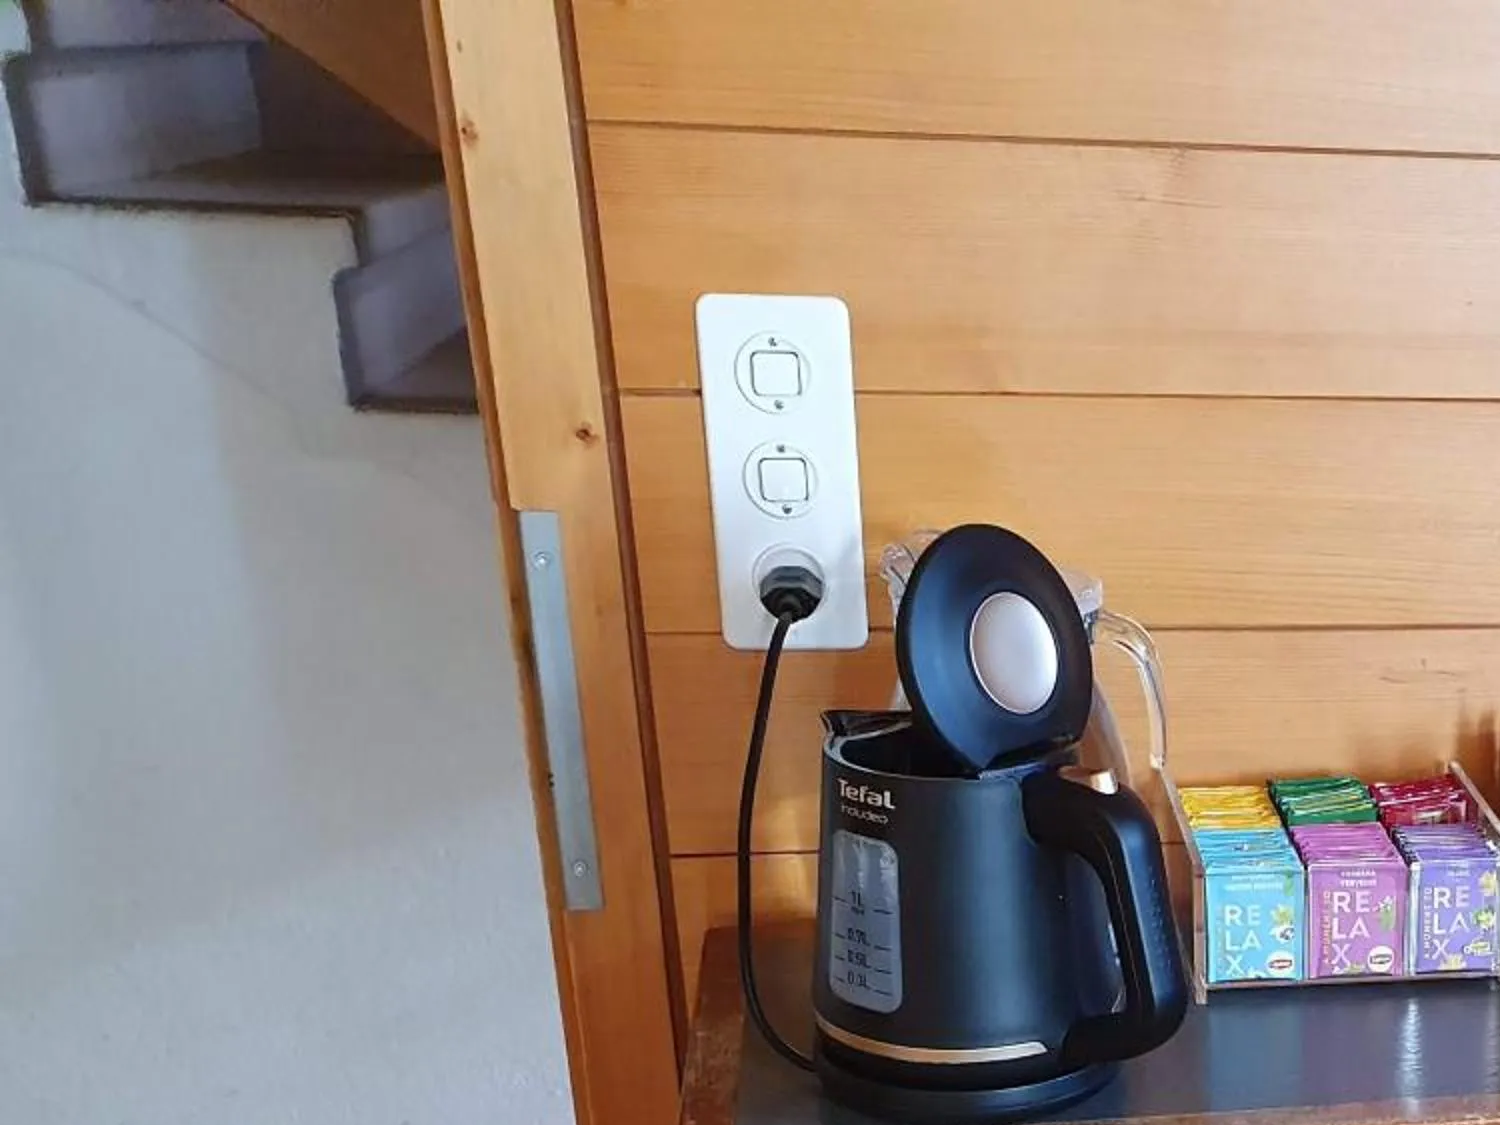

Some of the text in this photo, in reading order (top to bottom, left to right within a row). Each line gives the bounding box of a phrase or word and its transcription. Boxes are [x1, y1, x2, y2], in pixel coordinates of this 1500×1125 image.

[837, 777, 896, 809] Tefal
[1332, 891, 1371, 913] RE
[1433, 886, 1470, 909] RE
[1224, 904, 1261, 927] RE
[1433, 912, 1470, 935] LA
[1332, 917, 1370, 940] LA
[1225, 930, 1261, 951] LA
[1432, 939, 1451, 960] X
[1225, 954, 1245, 976] X
[1331, 943, 1351, 966] X
